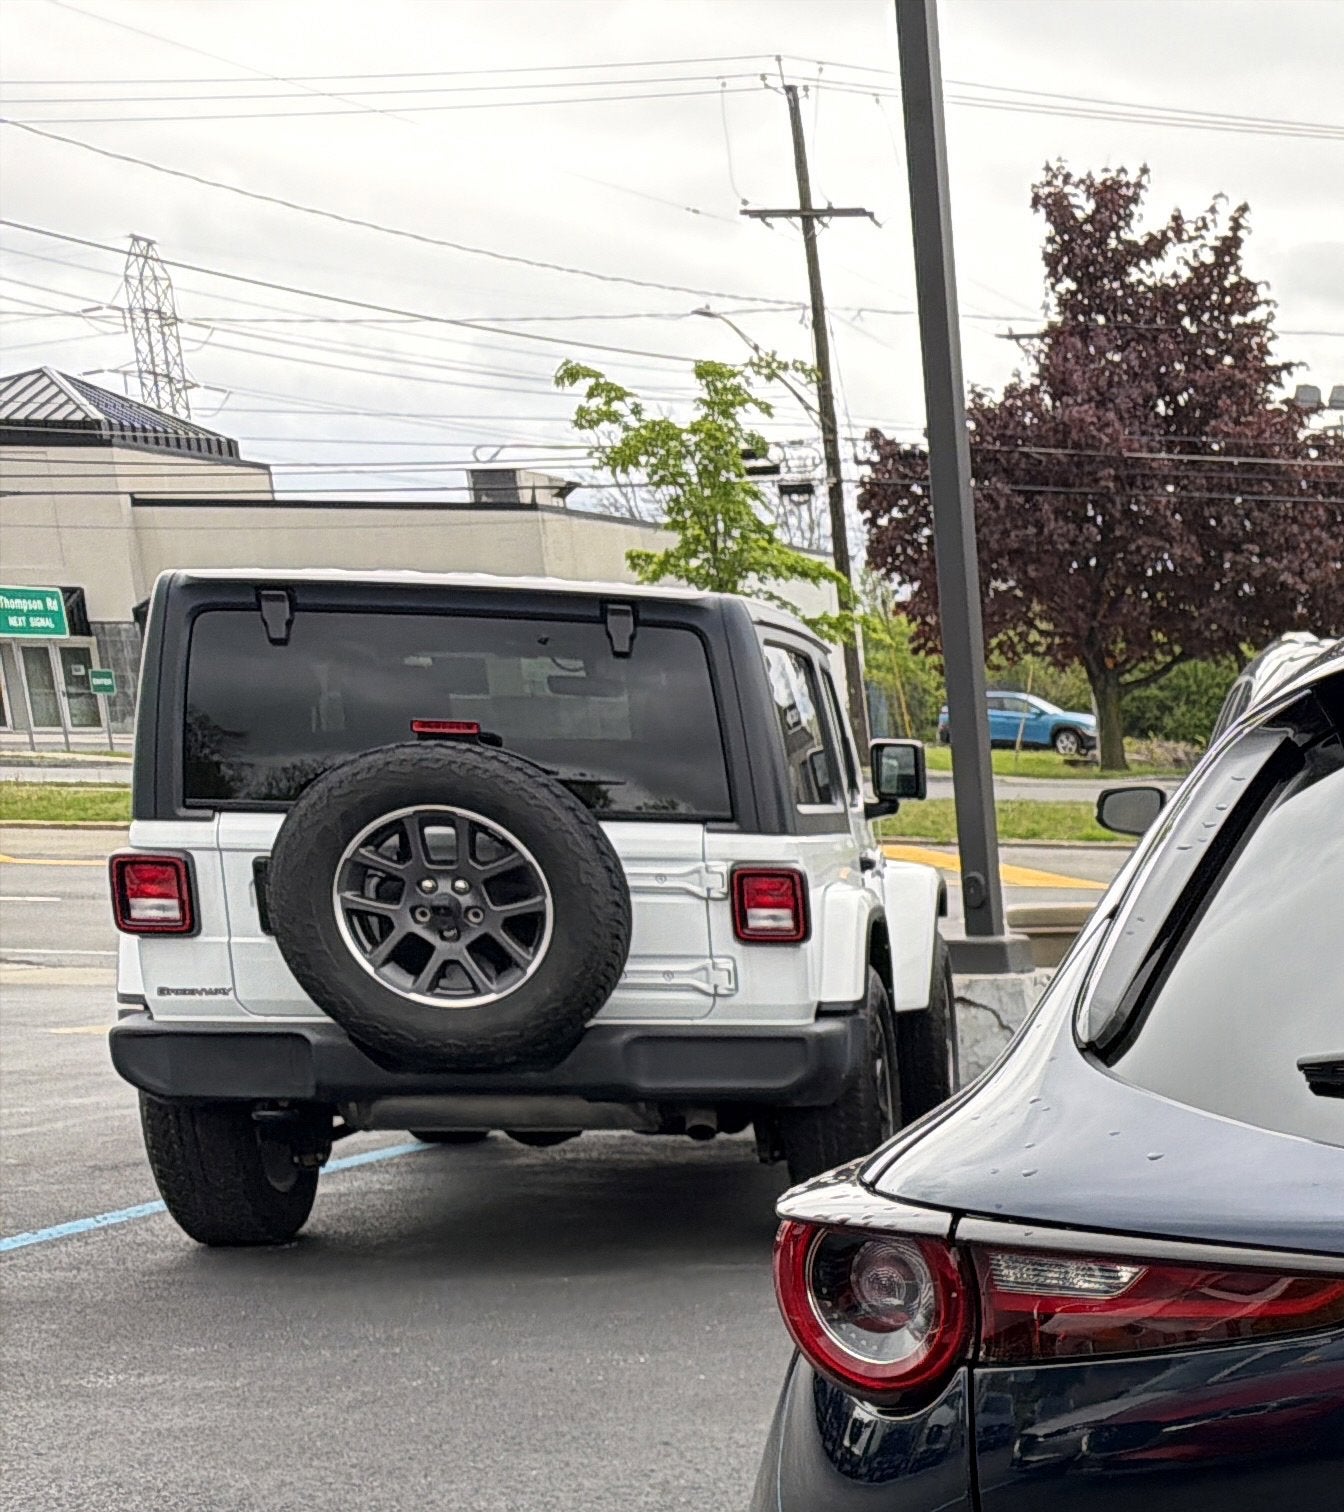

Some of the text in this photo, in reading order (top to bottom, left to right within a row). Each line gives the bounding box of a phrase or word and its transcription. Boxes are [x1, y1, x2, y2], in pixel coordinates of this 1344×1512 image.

[0, 596, 58, 612] Thompson Rd
[8, 616, 55, 628] NEXT SIGNAL
